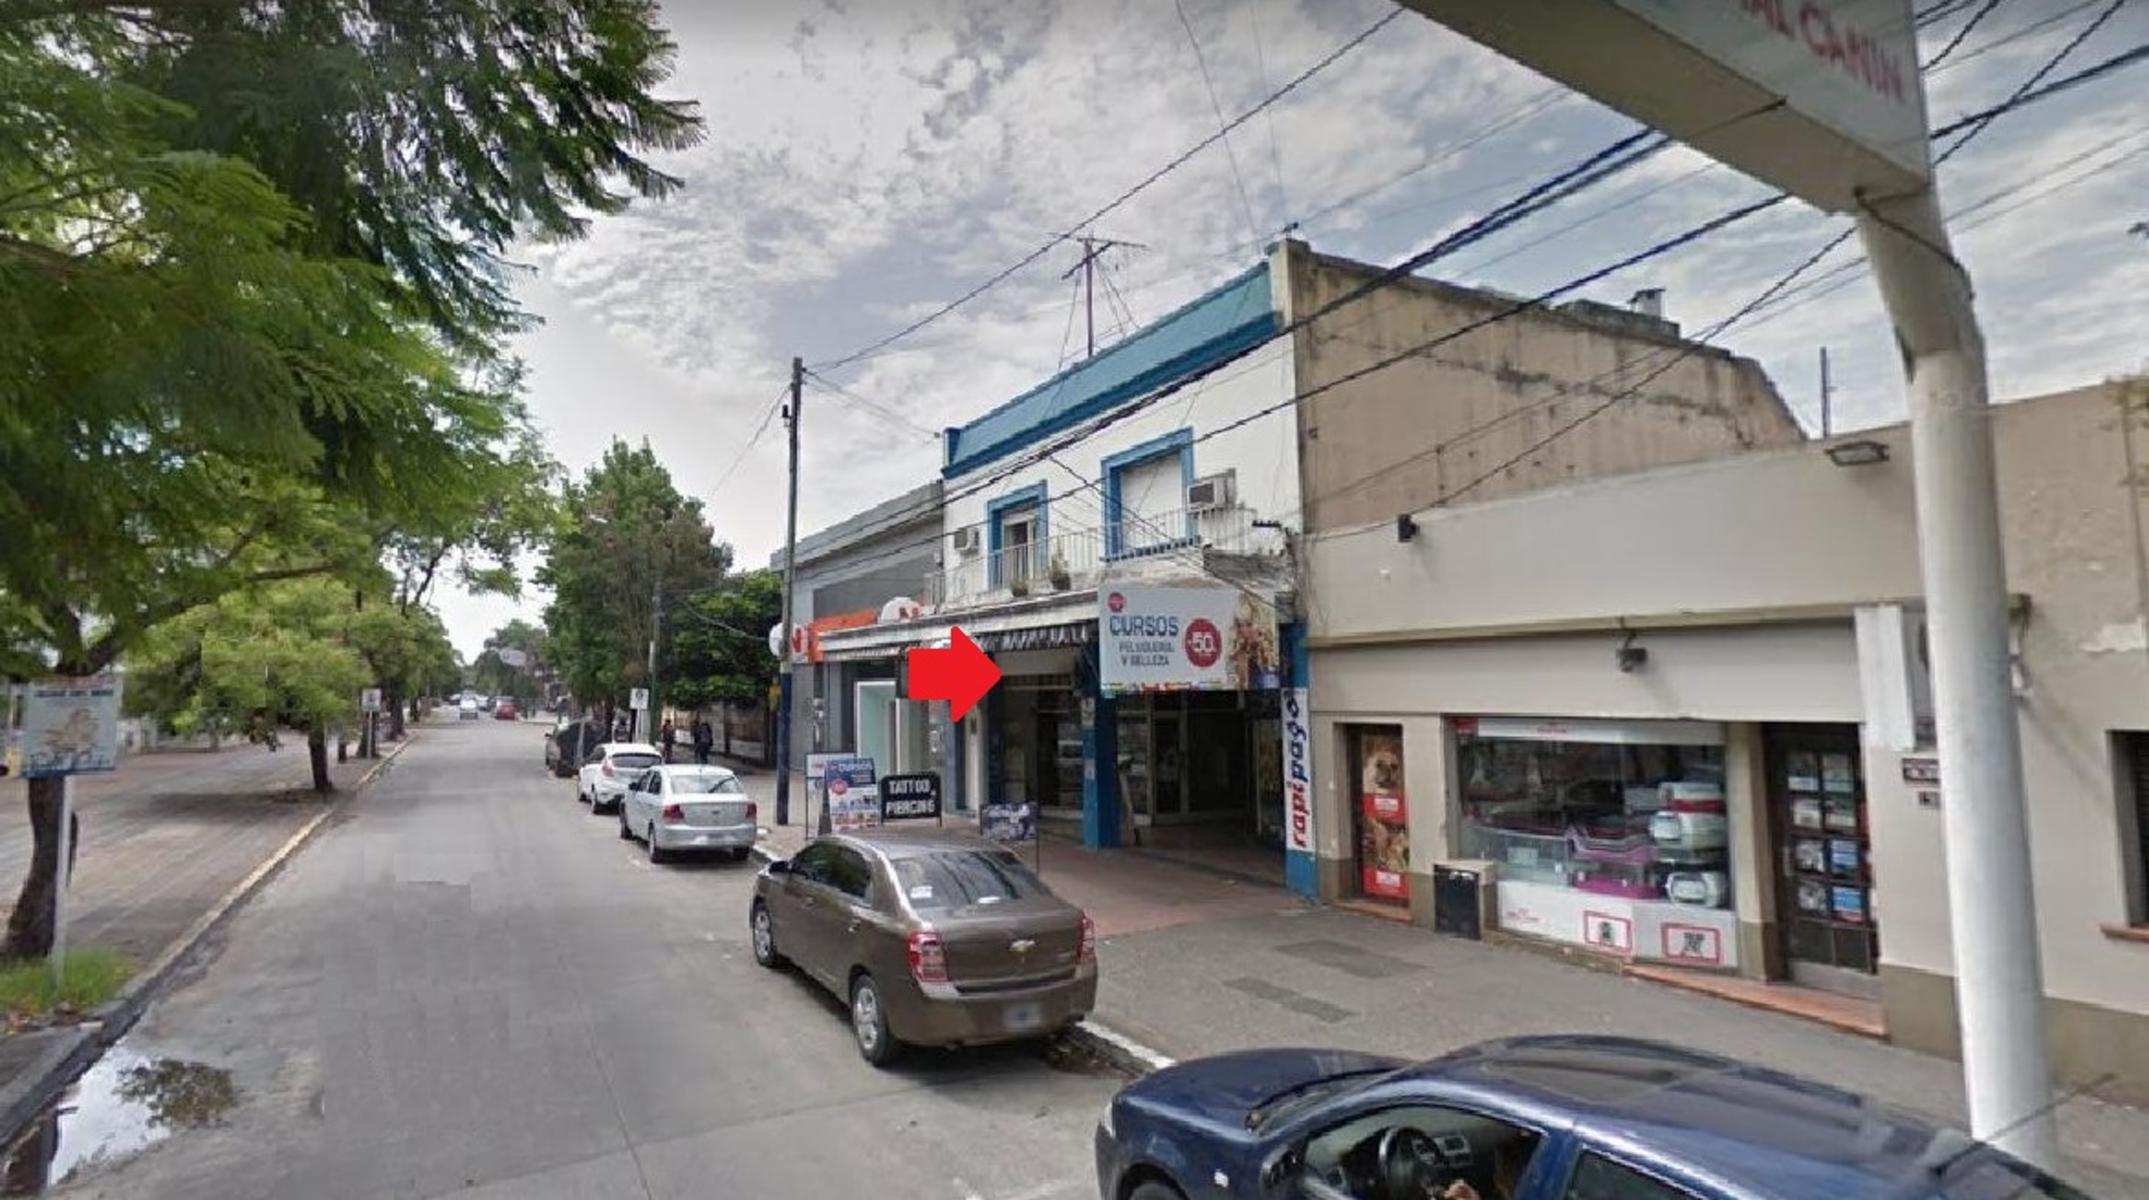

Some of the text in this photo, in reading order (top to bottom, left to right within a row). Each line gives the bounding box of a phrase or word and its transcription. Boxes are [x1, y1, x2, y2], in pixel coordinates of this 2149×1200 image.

[1109, 615, 1179, 637] CURSOS
[1286, 697, 1309, 849] rapipago
[888, 779, 931, 795] TATTOO
[885, 799, 936, 816] PIERCING
